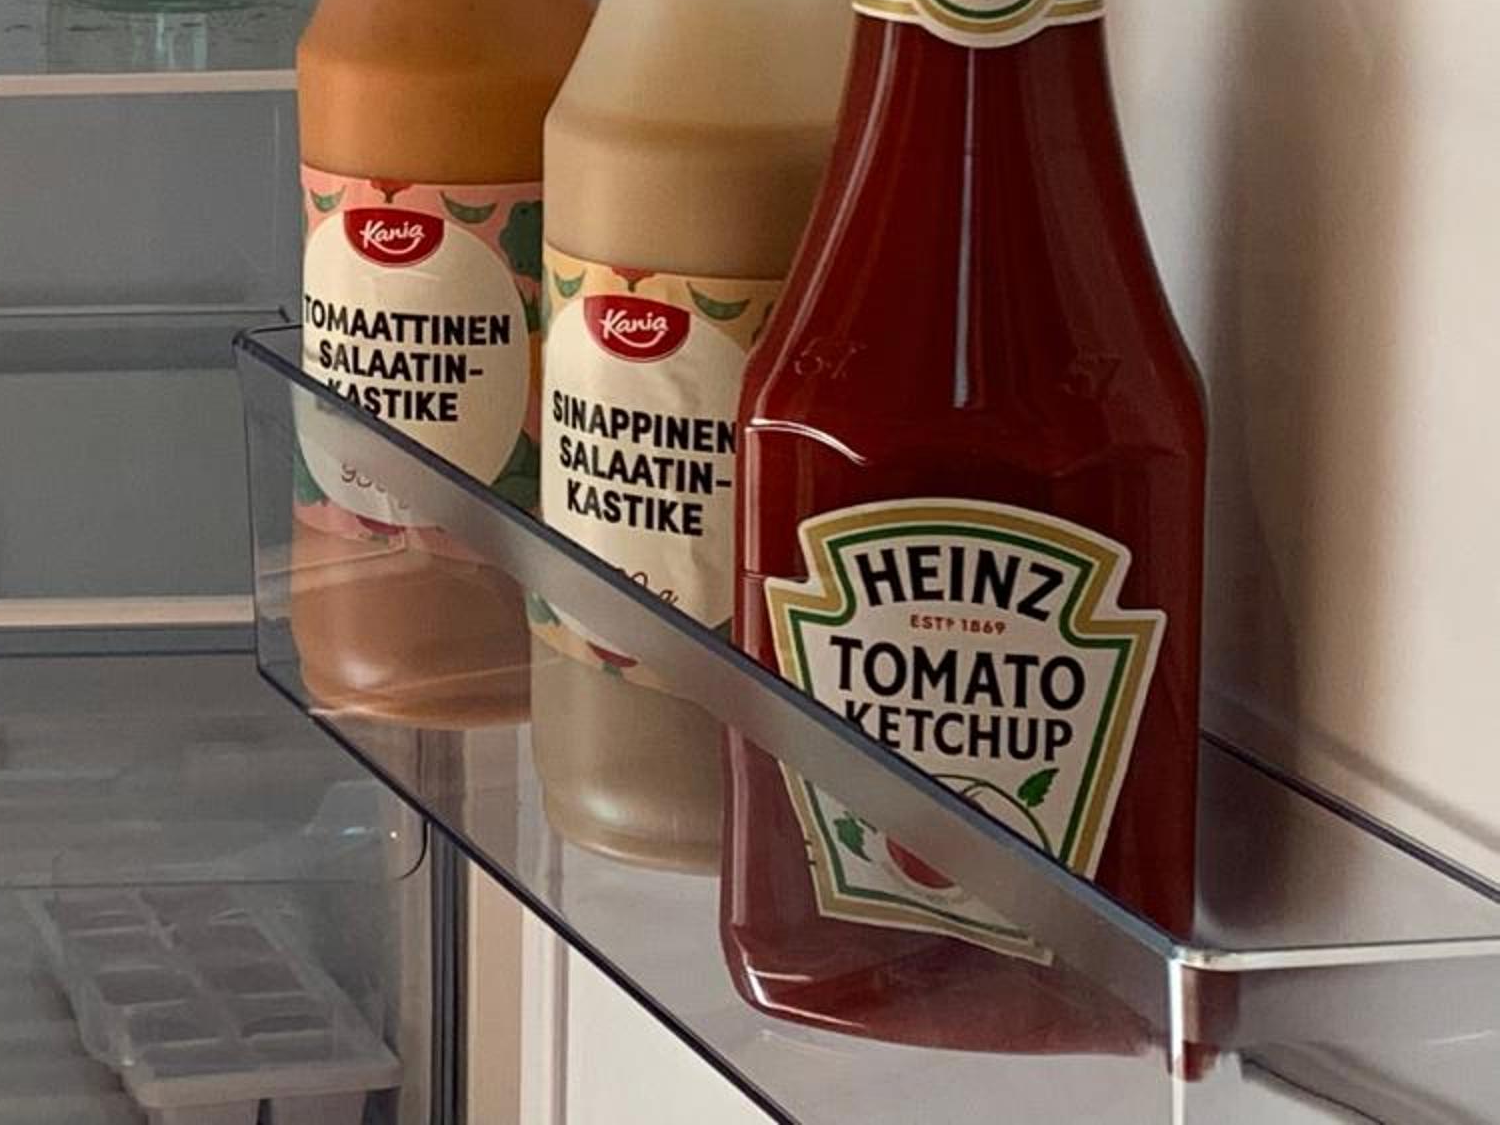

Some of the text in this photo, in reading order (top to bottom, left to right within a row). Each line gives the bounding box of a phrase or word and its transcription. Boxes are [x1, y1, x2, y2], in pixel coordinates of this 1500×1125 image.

[359, 219, 425, 252] Kania
[304, 293, 510, 346] TOMAATTINEN
[600, 308, 669, 343] Kania
[319, 339, 483, 384] SALAATIN-
[553, 389, 736, 454] SINAPPINEN
[559, 435, 732, 495] SALAATIN-
[567, 478, 703, 537] KASTIKE
[854, 544, 1065, 623] HEINZ
[962, 618, 1006, 636] 1869
[830, 635, 1086, 710] TOMATO
[845, 700, 1073, 762] KETCHUP
